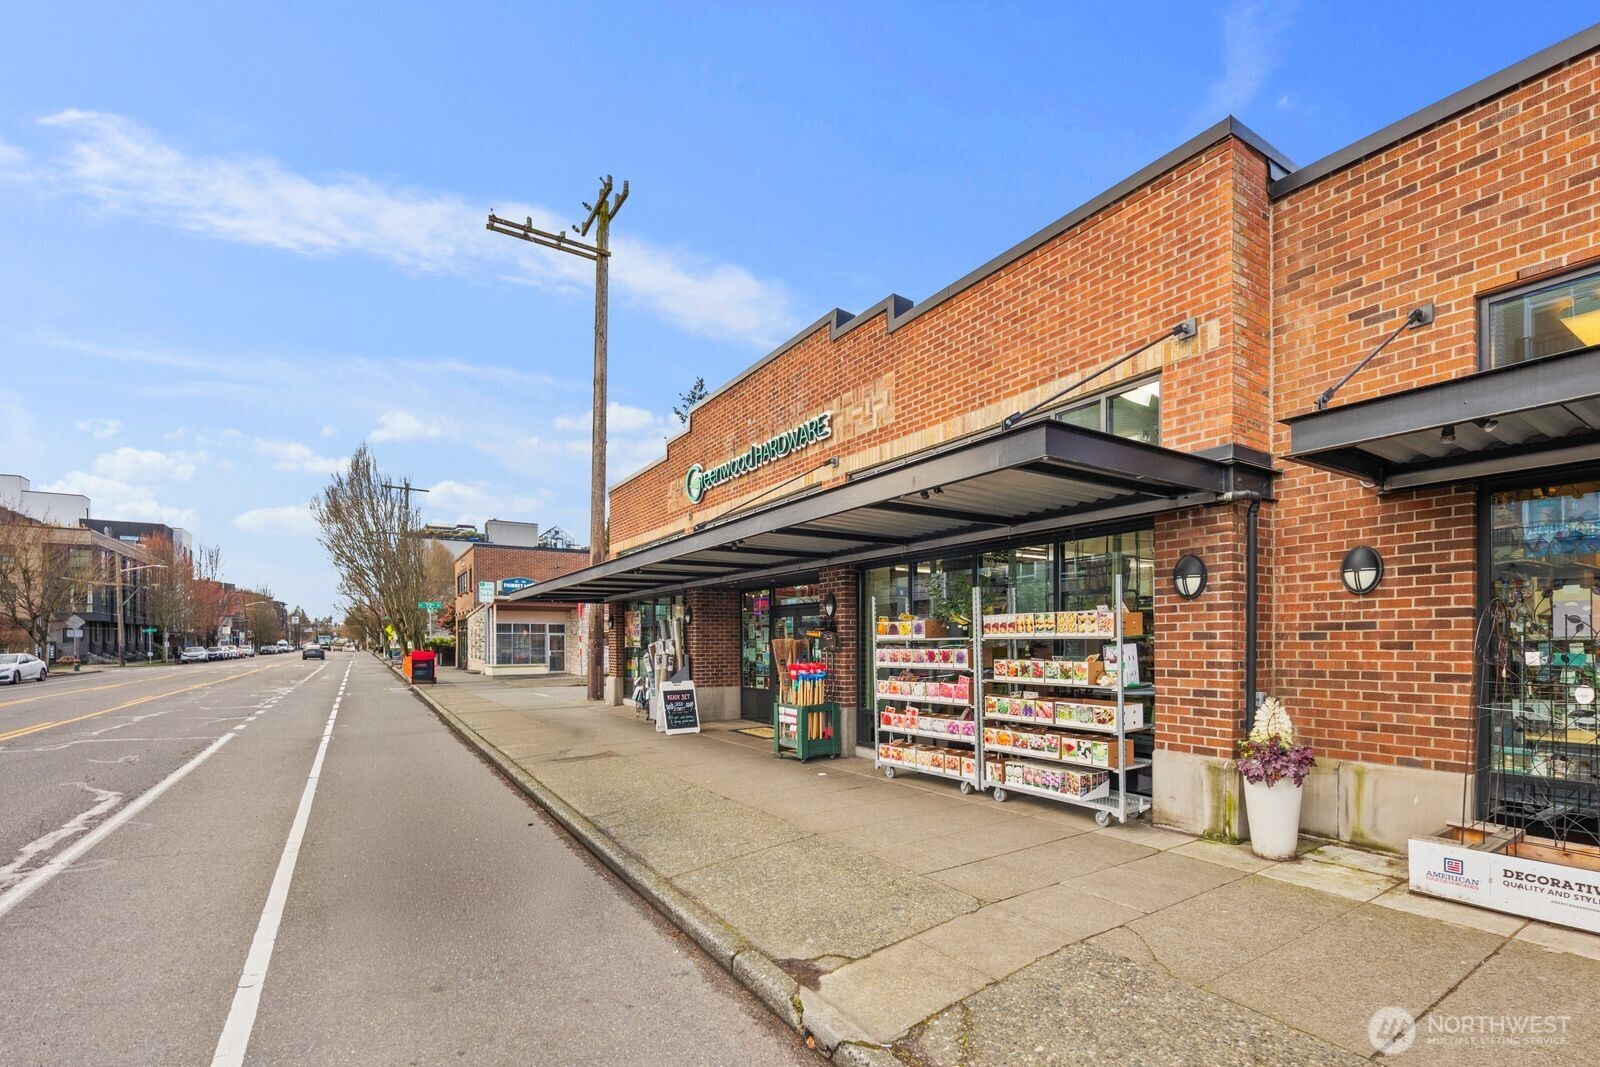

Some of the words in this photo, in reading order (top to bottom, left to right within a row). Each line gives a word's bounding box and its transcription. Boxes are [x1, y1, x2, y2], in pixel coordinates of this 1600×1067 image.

[686, 448, 756, 503] Greenwood
[753, 411, 832, 465] HARDWARE
[1426, 869, 1479, 886] AMERICAN
[1503, 880, 1545, 894] QUALITY
[1547, 889, 1571, 899] AND
[1573, 893, 1600, 905] STYL
